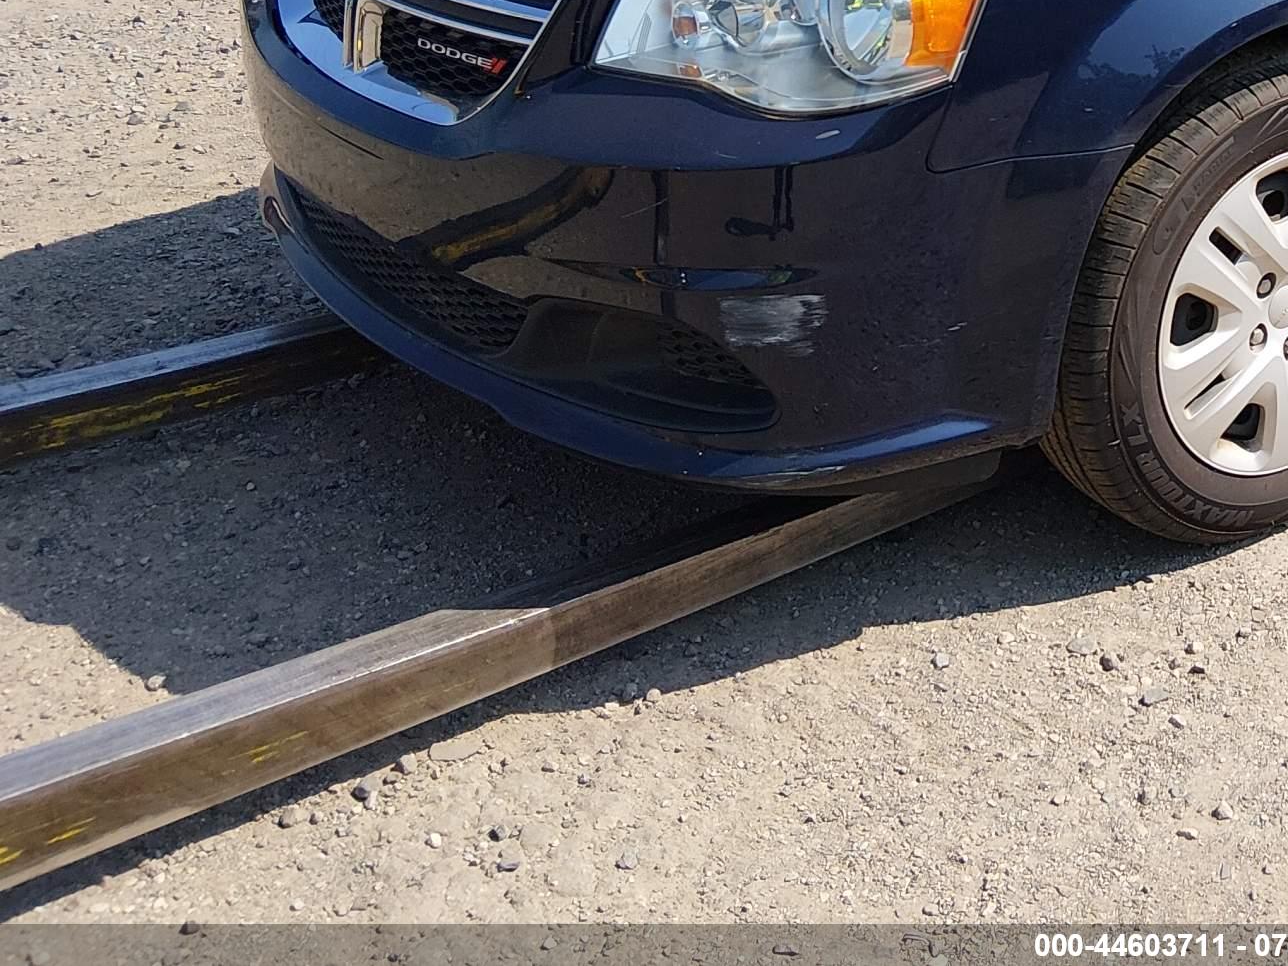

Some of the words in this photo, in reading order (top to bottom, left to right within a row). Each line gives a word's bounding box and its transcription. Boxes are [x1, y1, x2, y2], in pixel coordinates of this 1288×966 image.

[417, 37, 493, 69] DODGE
[1119, 401, 1149, 447] LX
[1135, 449, 1255, 527] MAXTOUR
